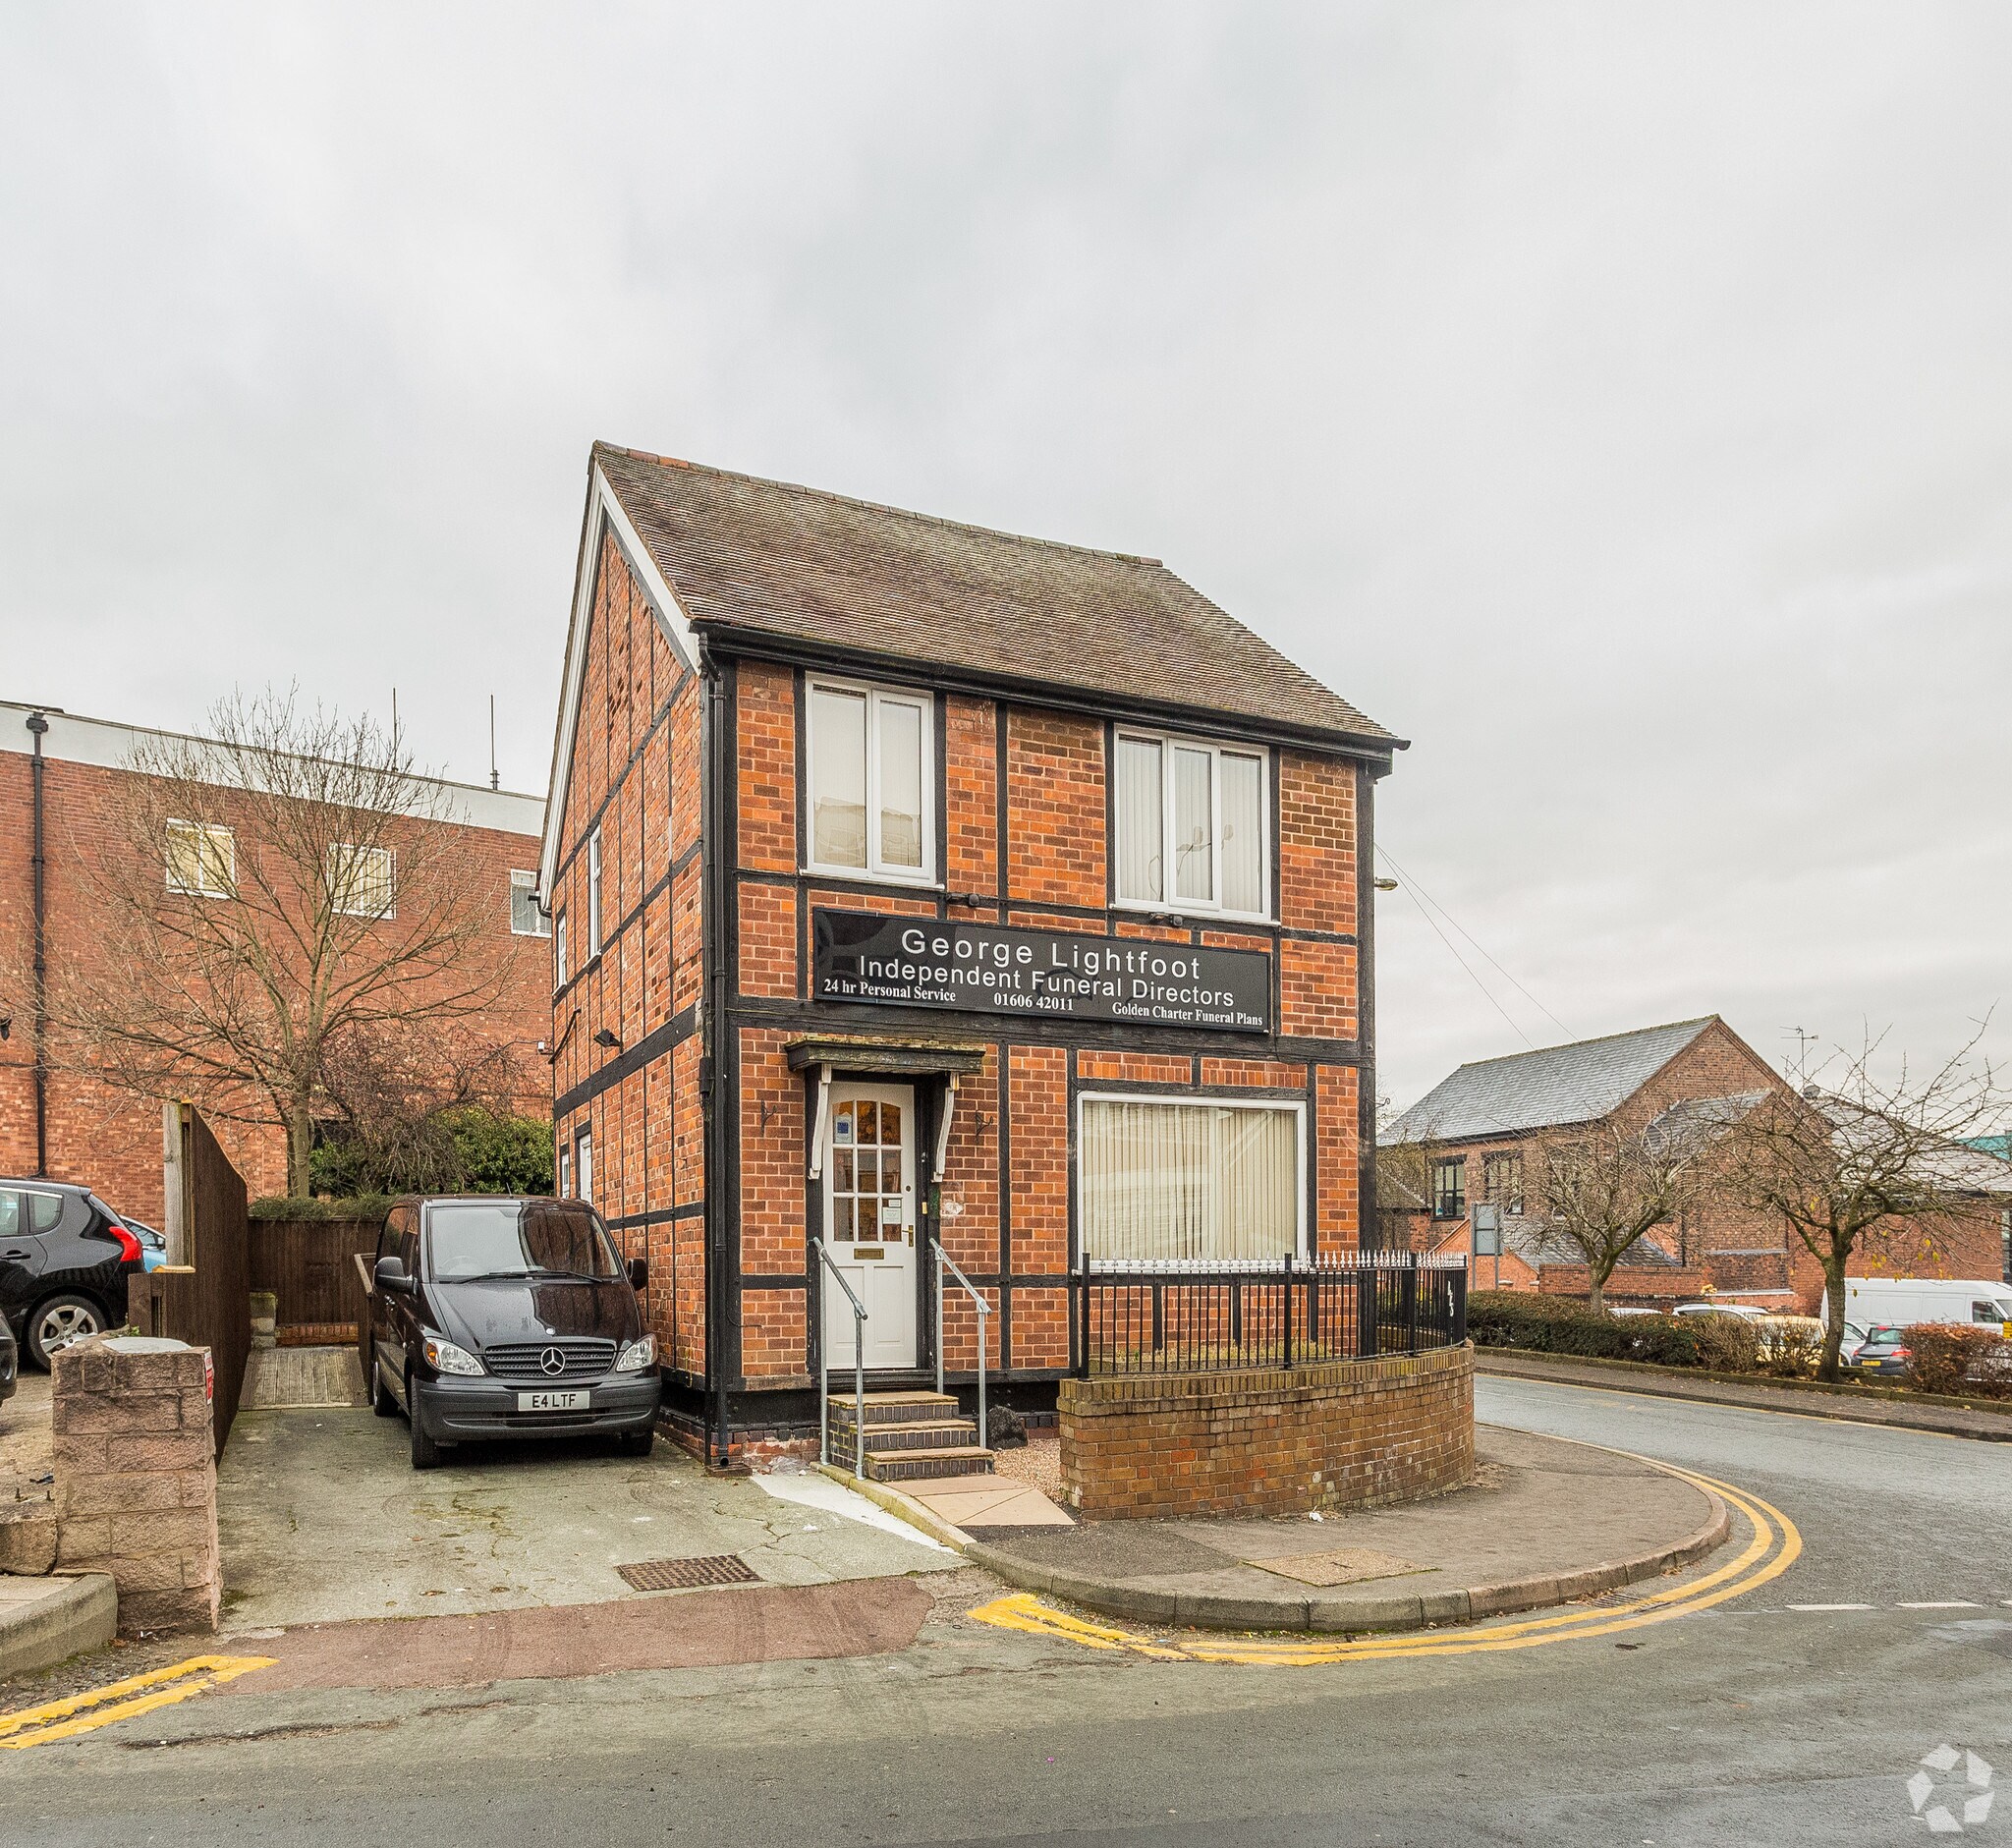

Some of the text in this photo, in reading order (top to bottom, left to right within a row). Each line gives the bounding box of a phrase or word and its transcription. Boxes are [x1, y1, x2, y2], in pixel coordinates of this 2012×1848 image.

[902, 928, 1201, 980] George Lightfoot
[823, 978, 956, 1002] 24 hr Personal Service
[860, 955, 1234, 1007] Independent Funeral Directors
[993, 991, 1074, 1011] 01606 42011
[1111, 1001, 1263, 1027] Golden Charter Funeral Plans
[531, 1393, 577, 1408] E4 LTF
